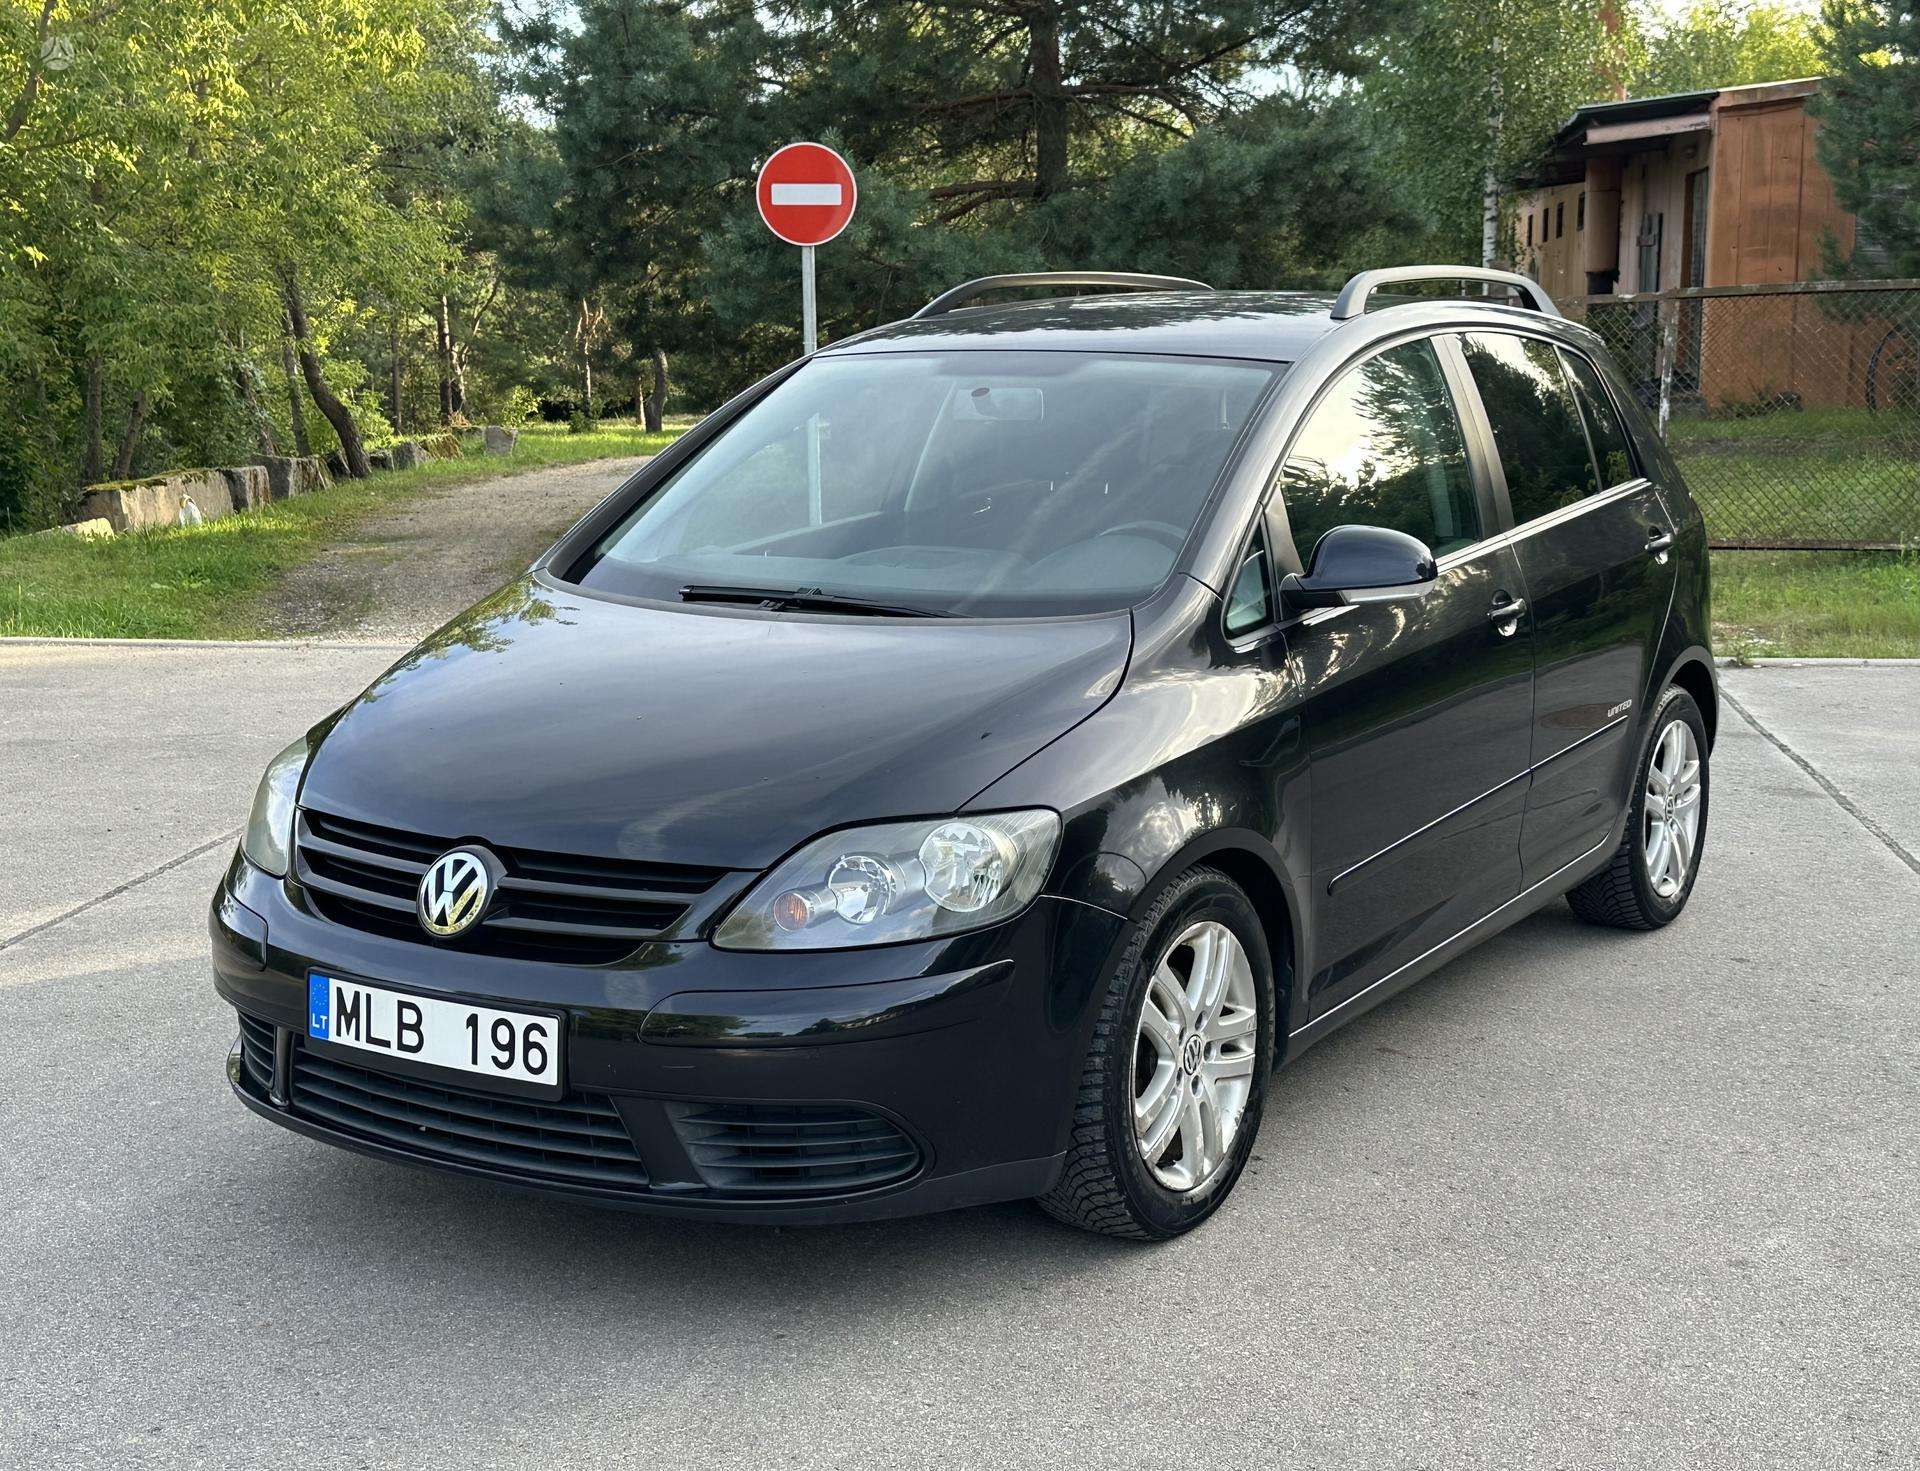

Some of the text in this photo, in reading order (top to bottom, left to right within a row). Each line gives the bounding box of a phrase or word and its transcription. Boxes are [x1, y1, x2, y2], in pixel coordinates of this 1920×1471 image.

[421, 853, 487, 934] VW
[312, 1013, 328, 1030] LT
[336, 986, 548, 1075] MLB 196
